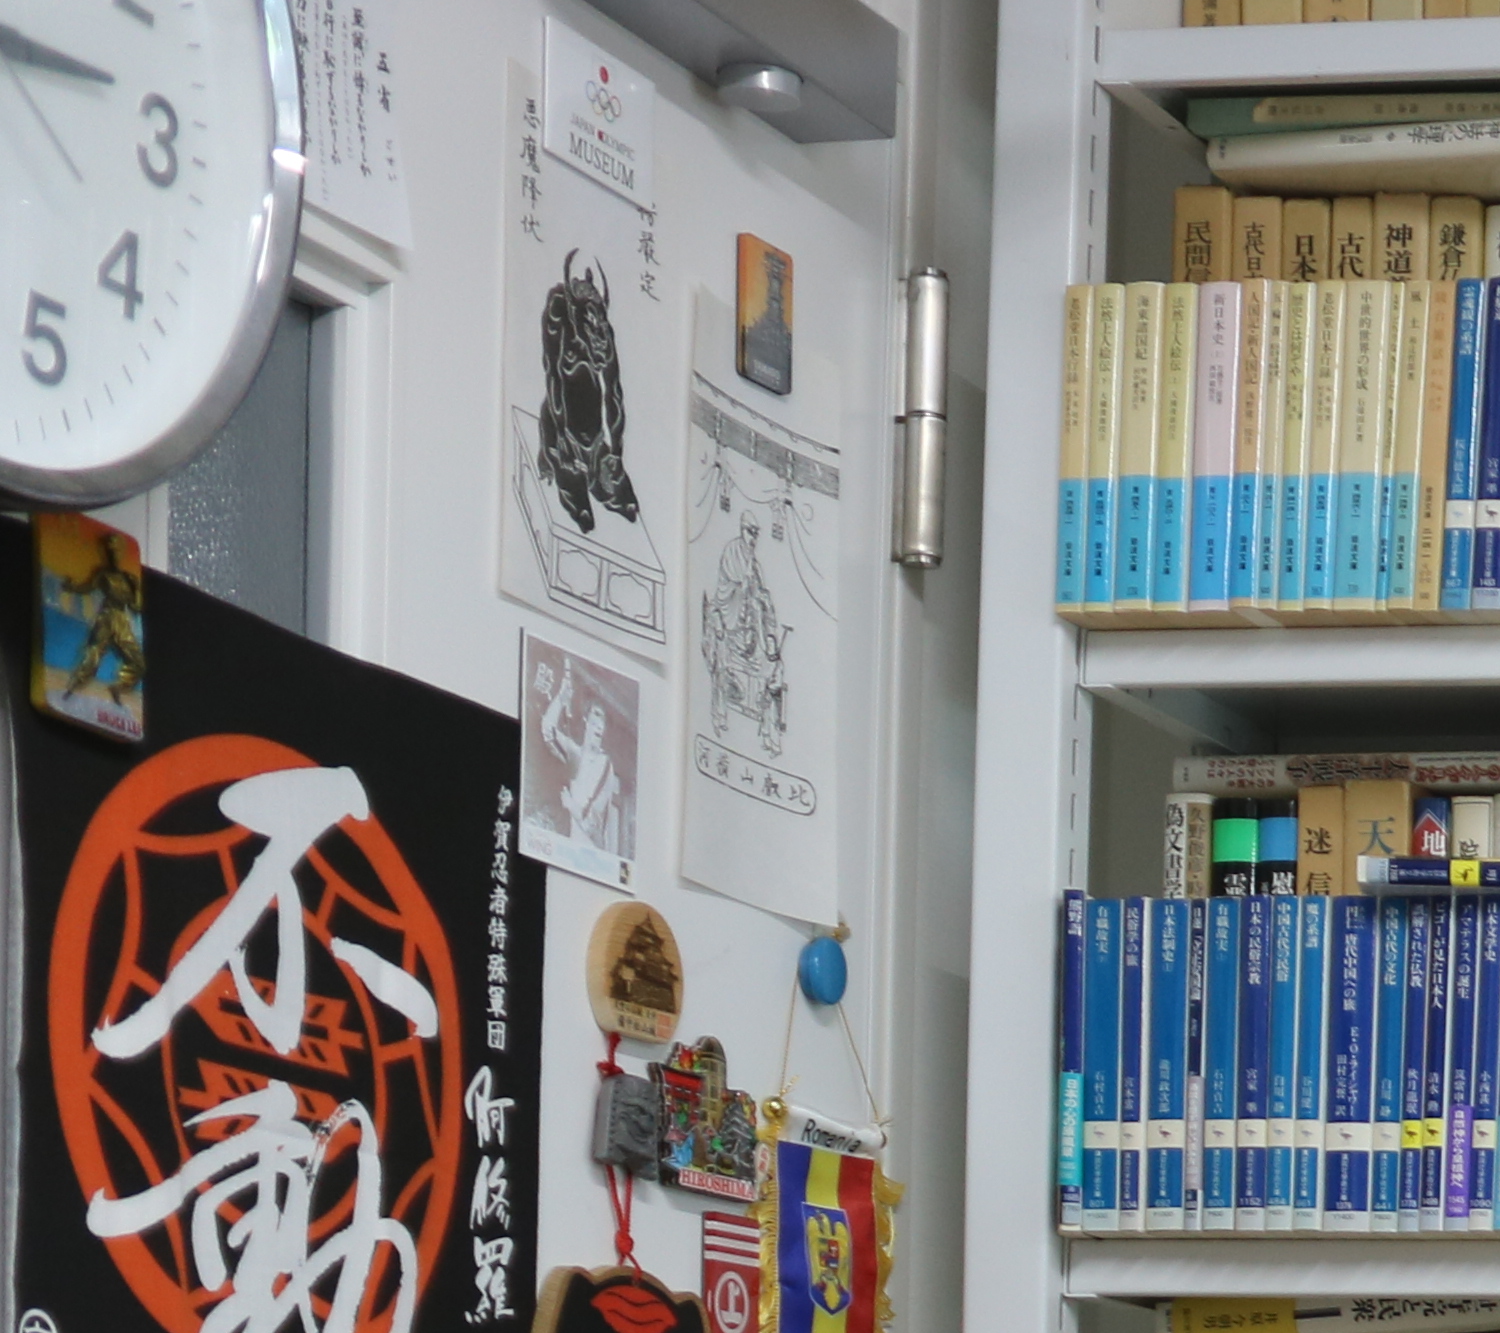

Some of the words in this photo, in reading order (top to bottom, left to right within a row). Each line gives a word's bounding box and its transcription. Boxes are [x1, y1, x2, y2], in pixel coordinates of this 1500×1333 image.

[137, 94, 180, 189] 3
[569, 132, 635, 190] MUSEUM
[99, 231, 143, 321] 4
[1383, 223, 1414, 280] 神道
[22, 290, 67, 386] 5
[1303, 827, 1333, 896] 迷信
[1357, 816, 1396, 856] 天
[801, 1119, 862, 1153] Romania
[680, 1169, 756, 1200] HIROSHIMA
